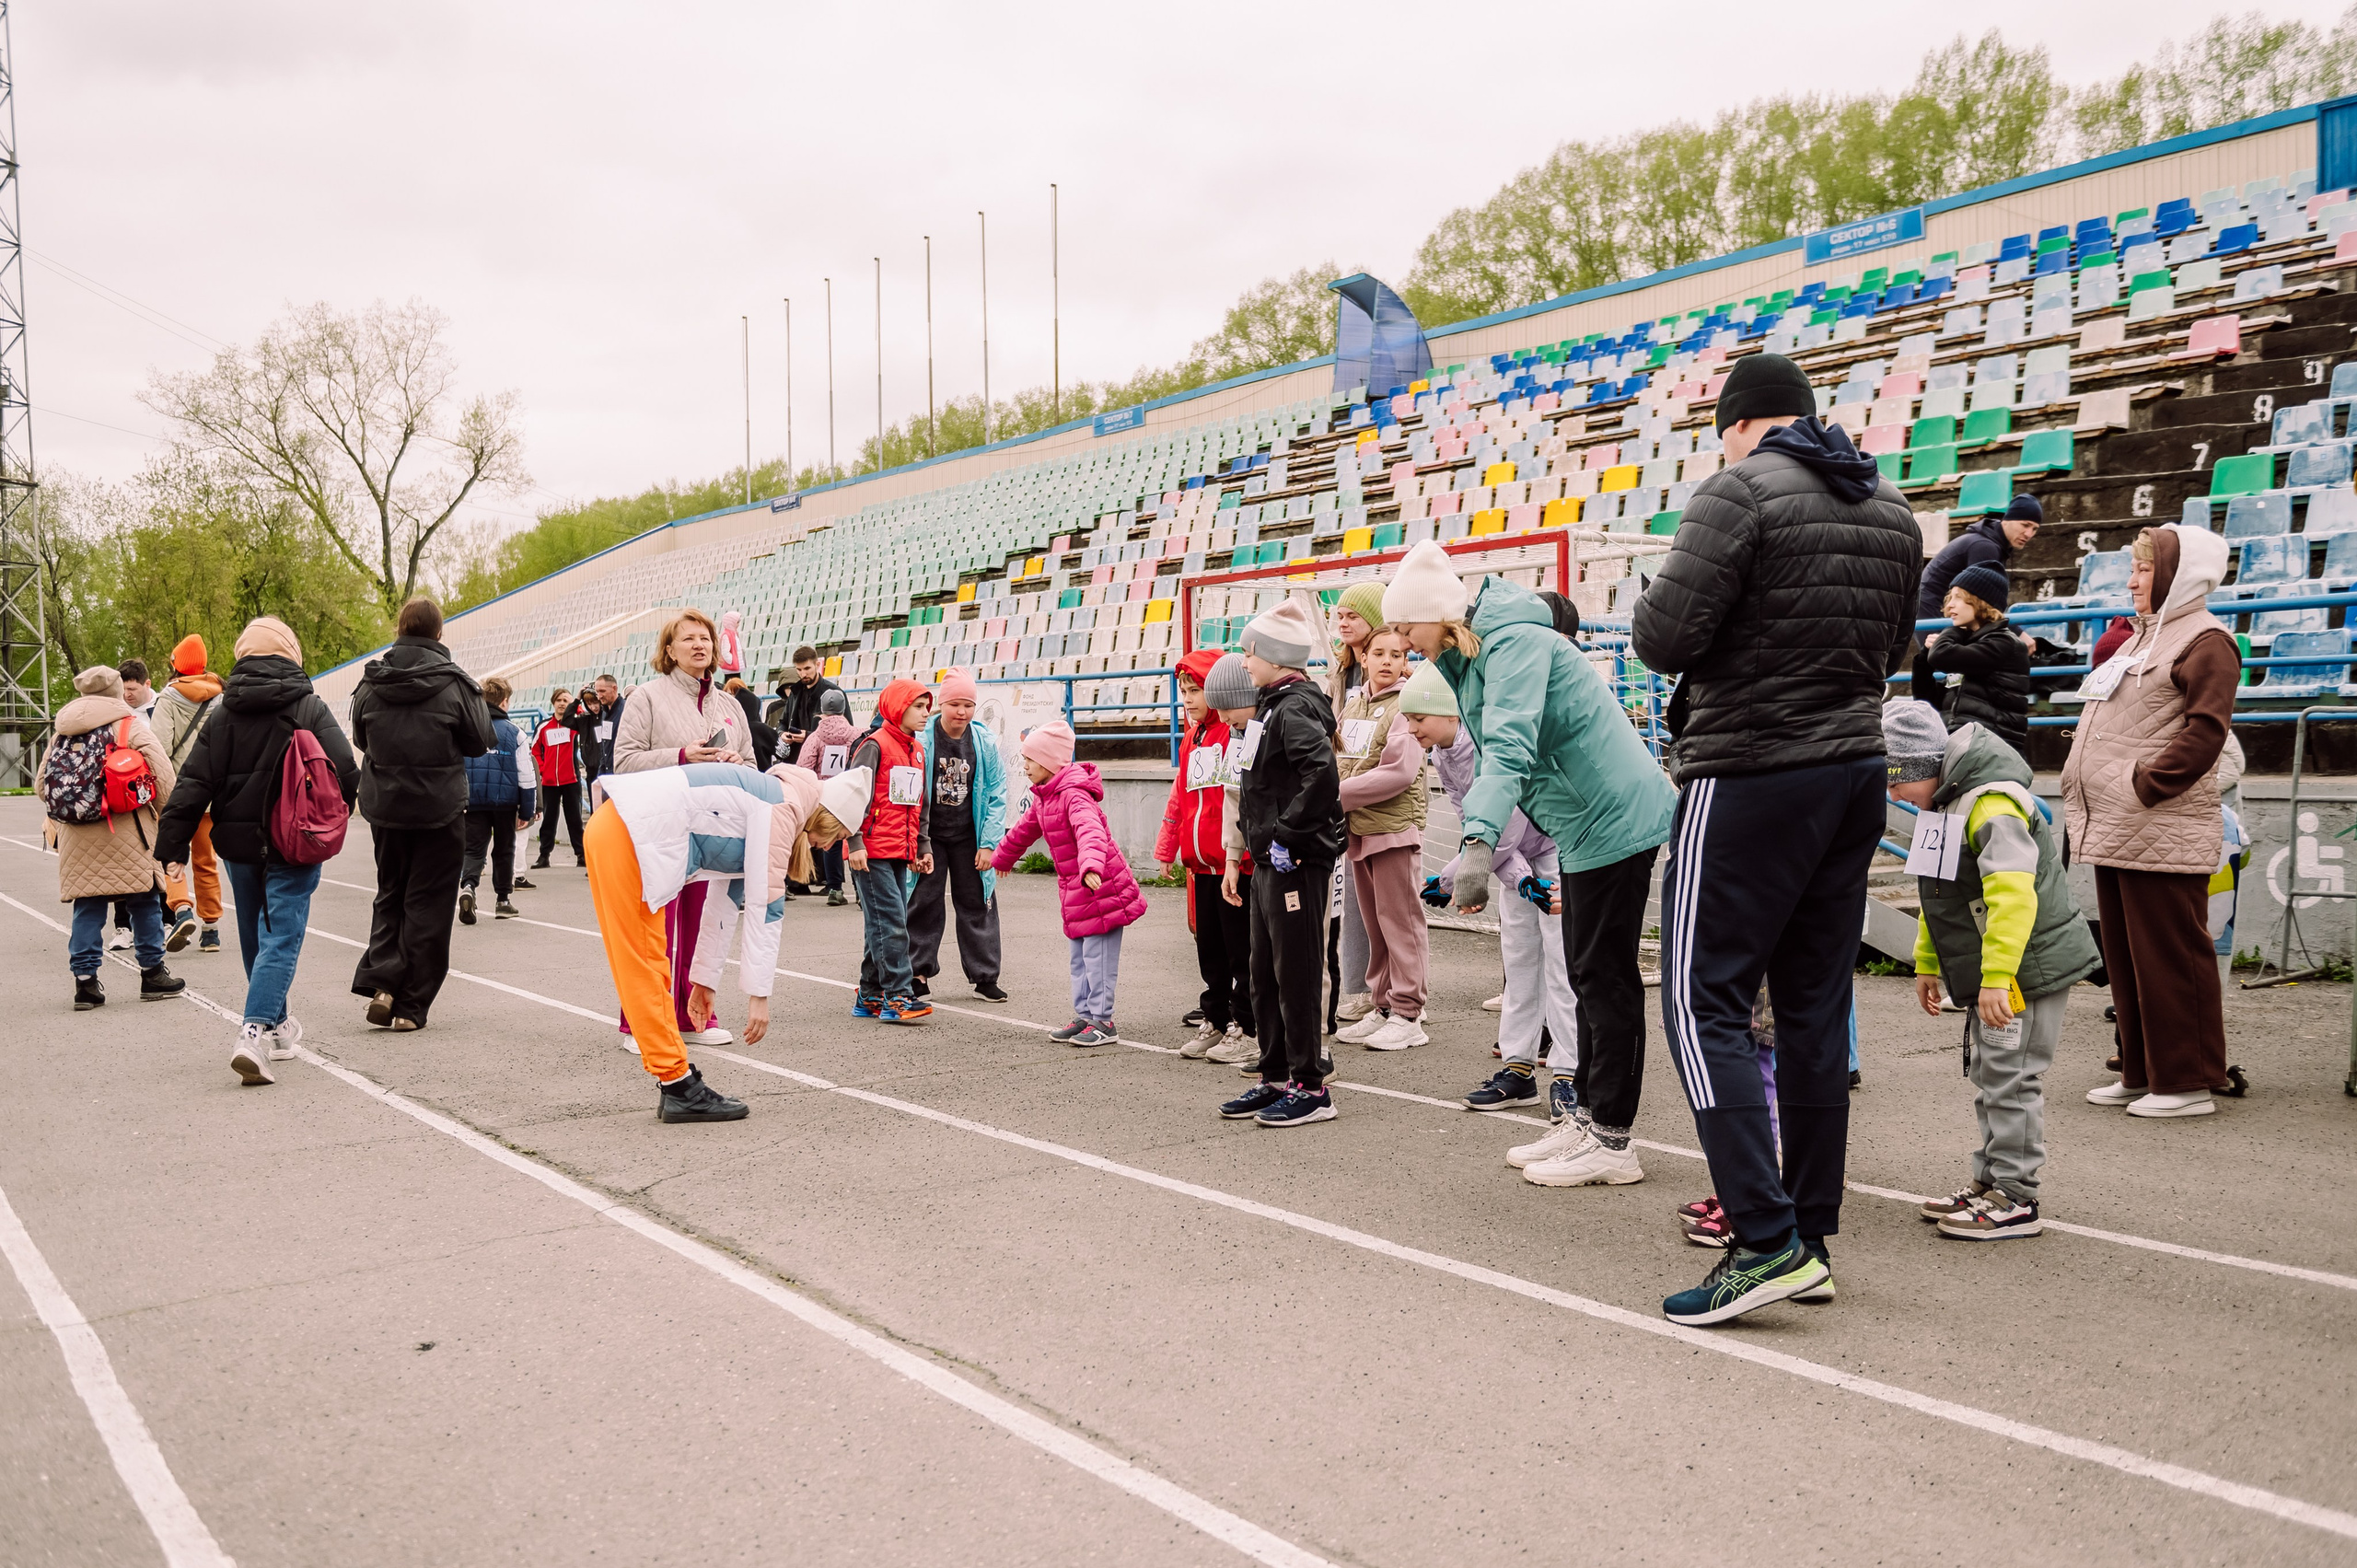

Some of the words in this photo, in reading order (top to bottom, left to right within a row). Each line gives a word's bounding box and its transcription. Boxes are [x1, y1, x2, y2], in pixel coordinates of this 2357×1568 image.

[1829, 226, 1874, 245] СЕКТОР
[2303, 360, 2324, 384] 9
[2252, 394, 2274, 423] 8
[2191, 443, 2209, 470] 7
[2131, 484, 2154, 517] 6
[1347, 722, 1358, 748] 4
[1194, 750, 1203, 779] 8
[907, 772, 915, 795] 7
[1921, 829, 1939, 850] 12
[1983, 1024, 2005, 1032] DREAM
